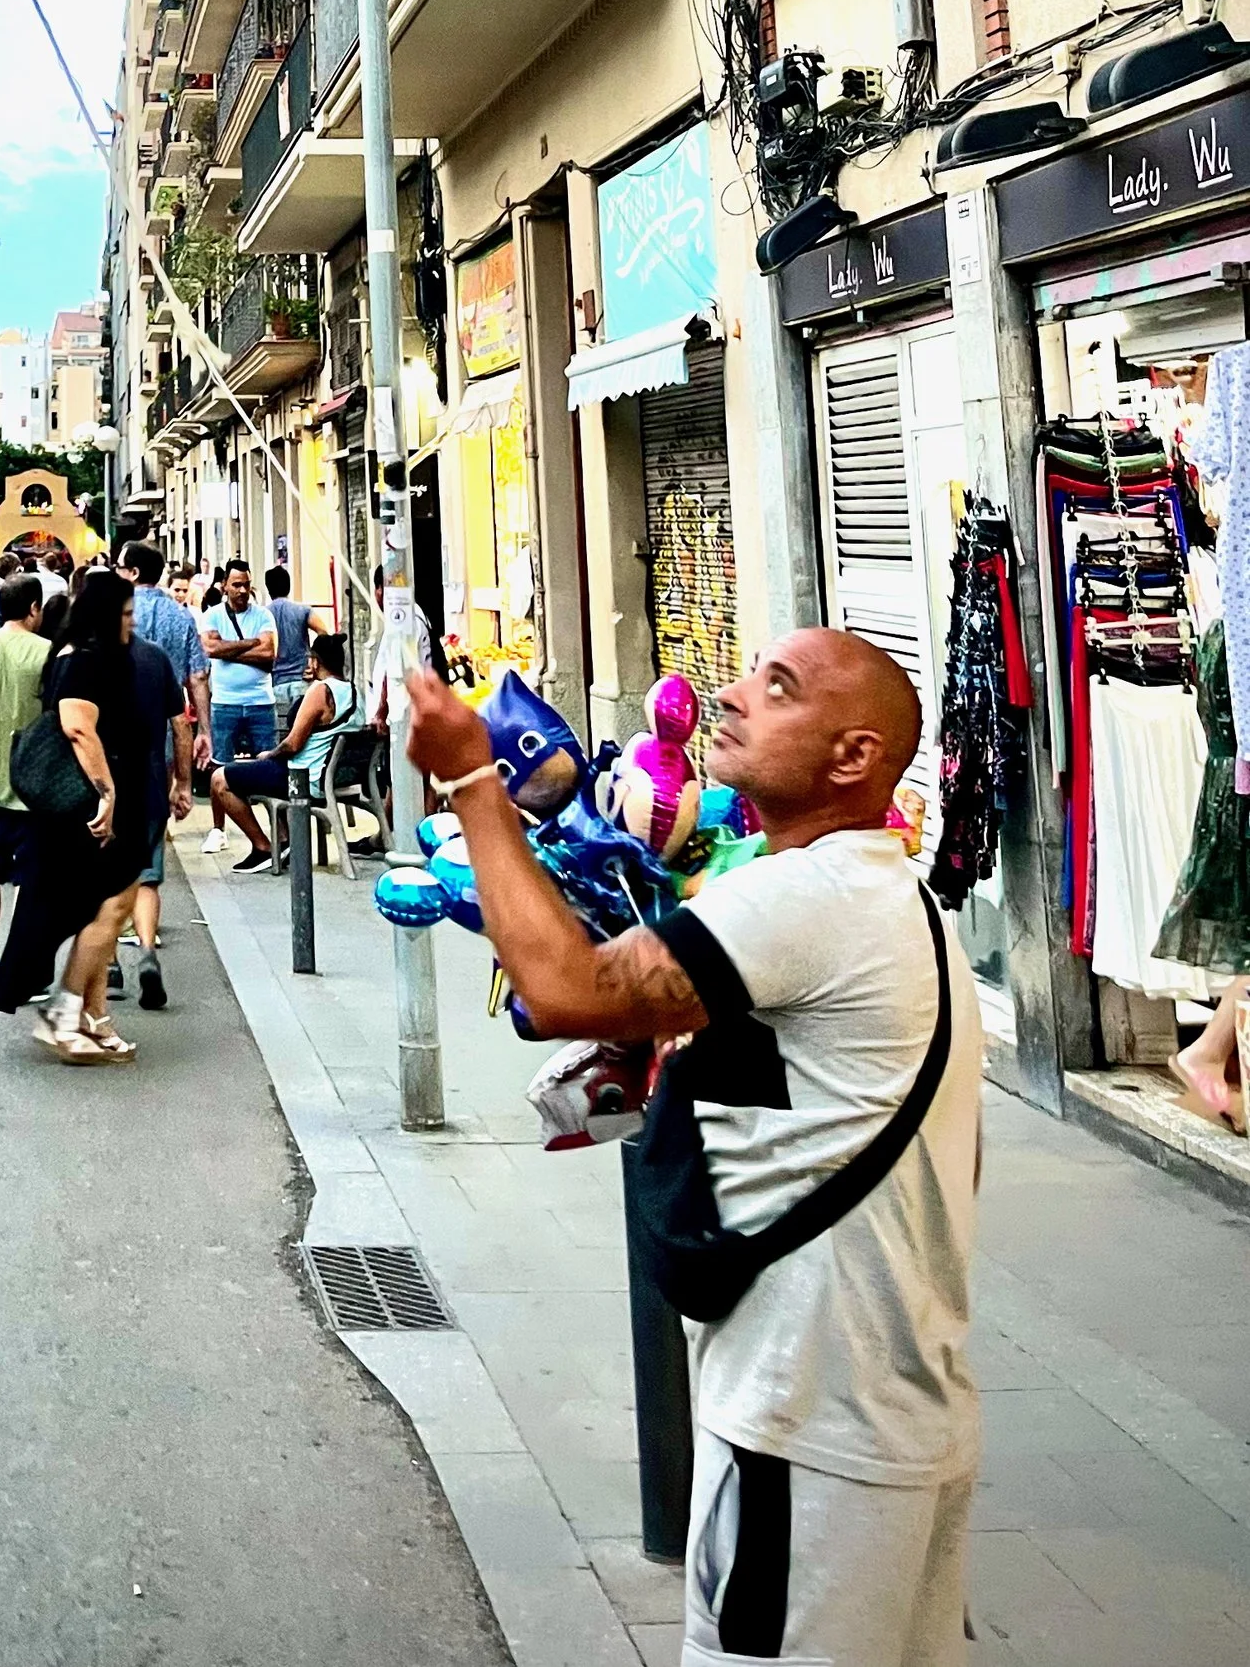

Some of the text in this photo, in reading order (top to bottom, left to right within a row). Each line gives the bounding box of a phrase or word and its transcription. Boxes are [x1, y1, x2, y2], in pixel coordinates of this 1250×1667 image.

[1108, 116, 1232, 208] Lady. Wu
[871, 234, 894, 282] Wu
